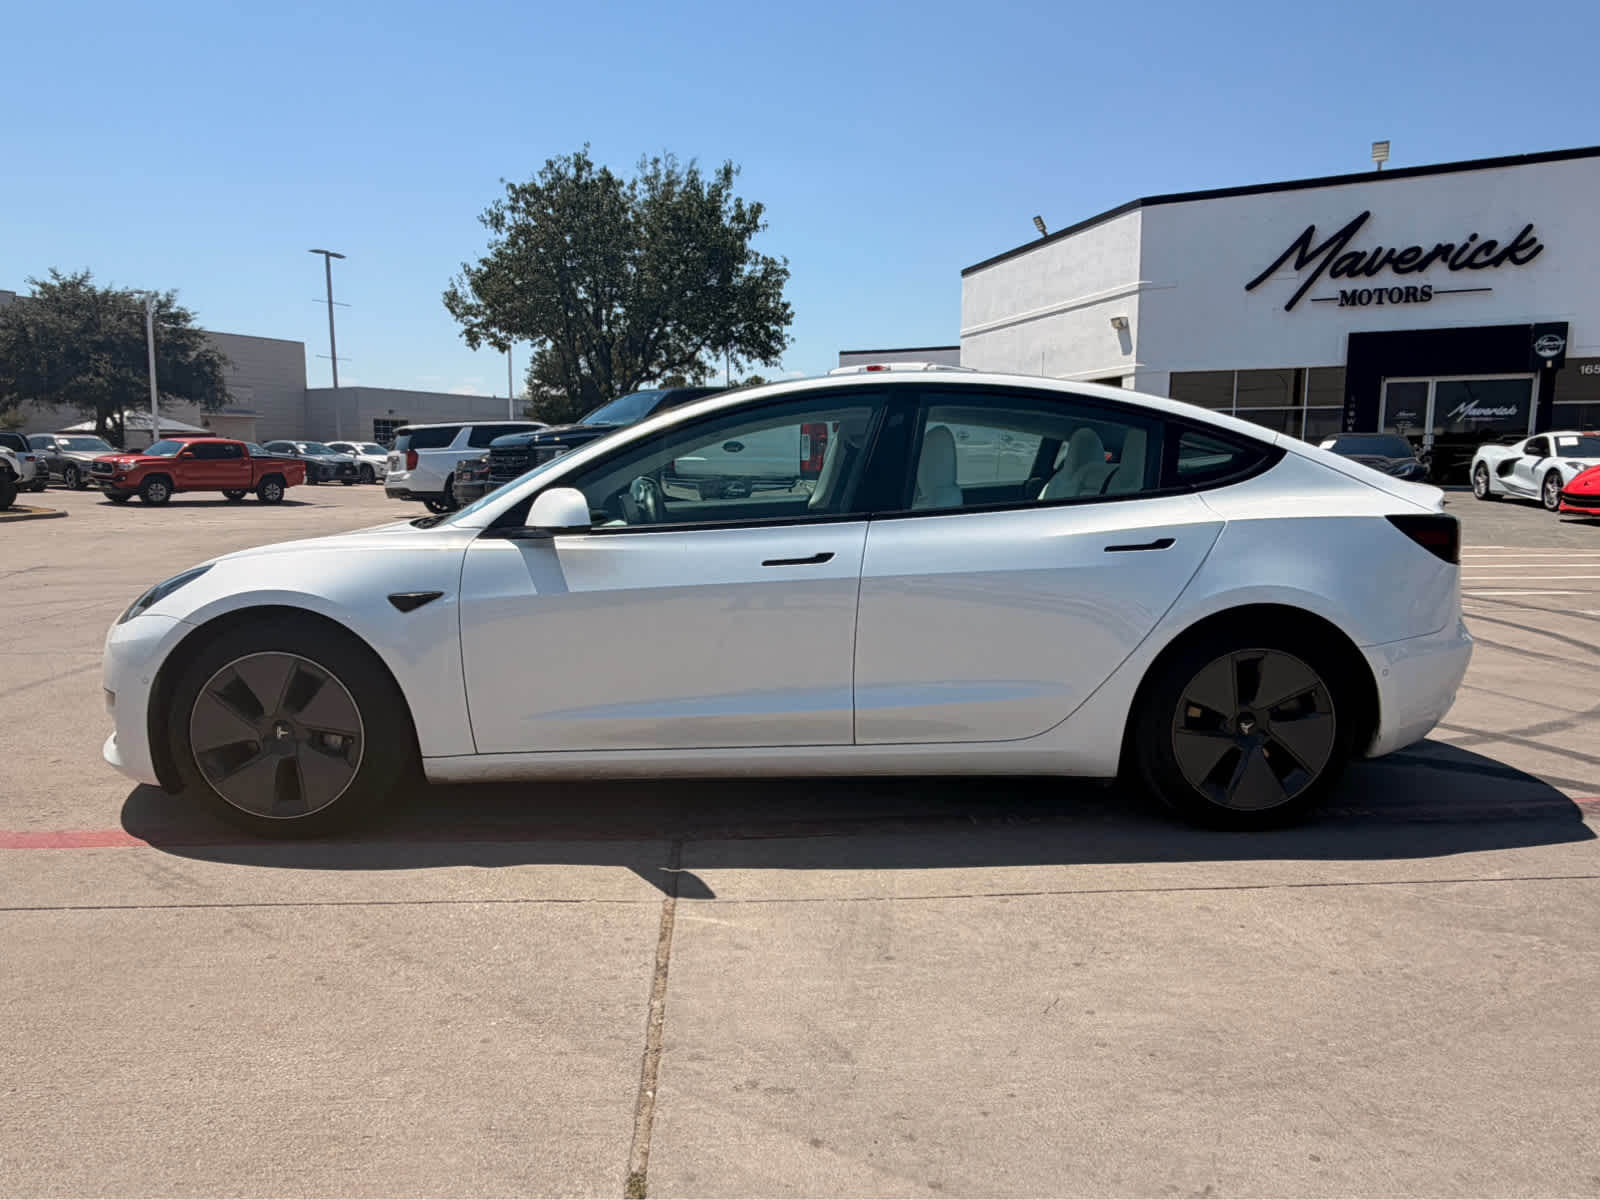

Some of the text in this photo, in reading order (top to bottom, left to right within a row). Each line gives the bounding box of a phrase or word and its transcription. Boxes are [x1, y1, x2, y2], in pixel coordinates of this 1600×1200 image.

[1246, 210, 1544, 312] Maverick
[1338, 285, 1433, 307] MOTORS
[1447, 399, 1518, 422] Maverick
